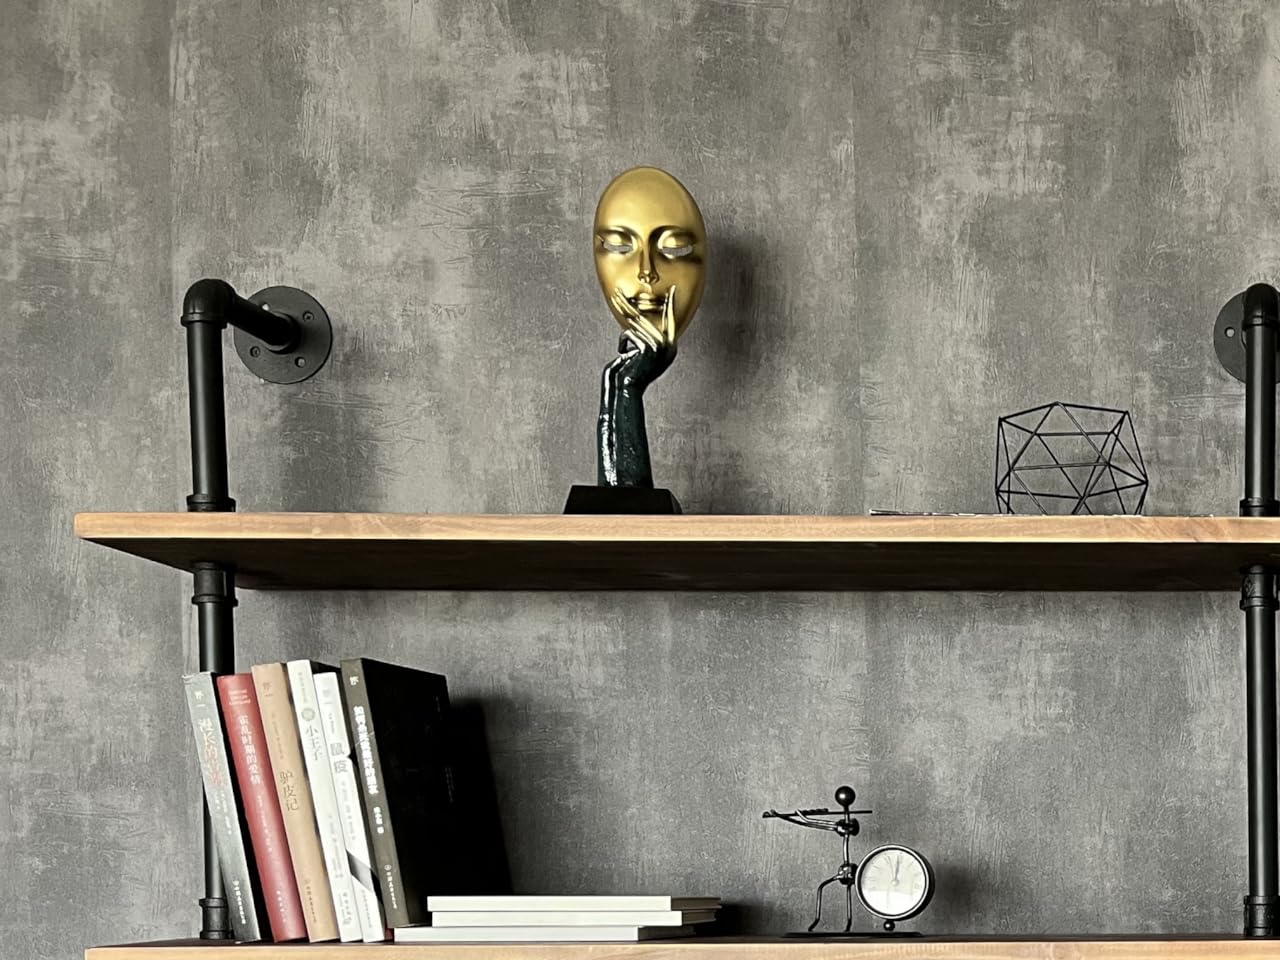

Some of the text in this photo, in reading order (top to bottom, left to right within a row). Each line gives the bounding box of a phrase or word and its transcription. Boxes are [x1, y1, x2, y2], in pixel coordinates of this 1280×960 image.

[304, 724, 322, 761] 小王子
[330, 742, 348, 774] 鼠疫
[280, 770, 299, 811] 驴皮记
